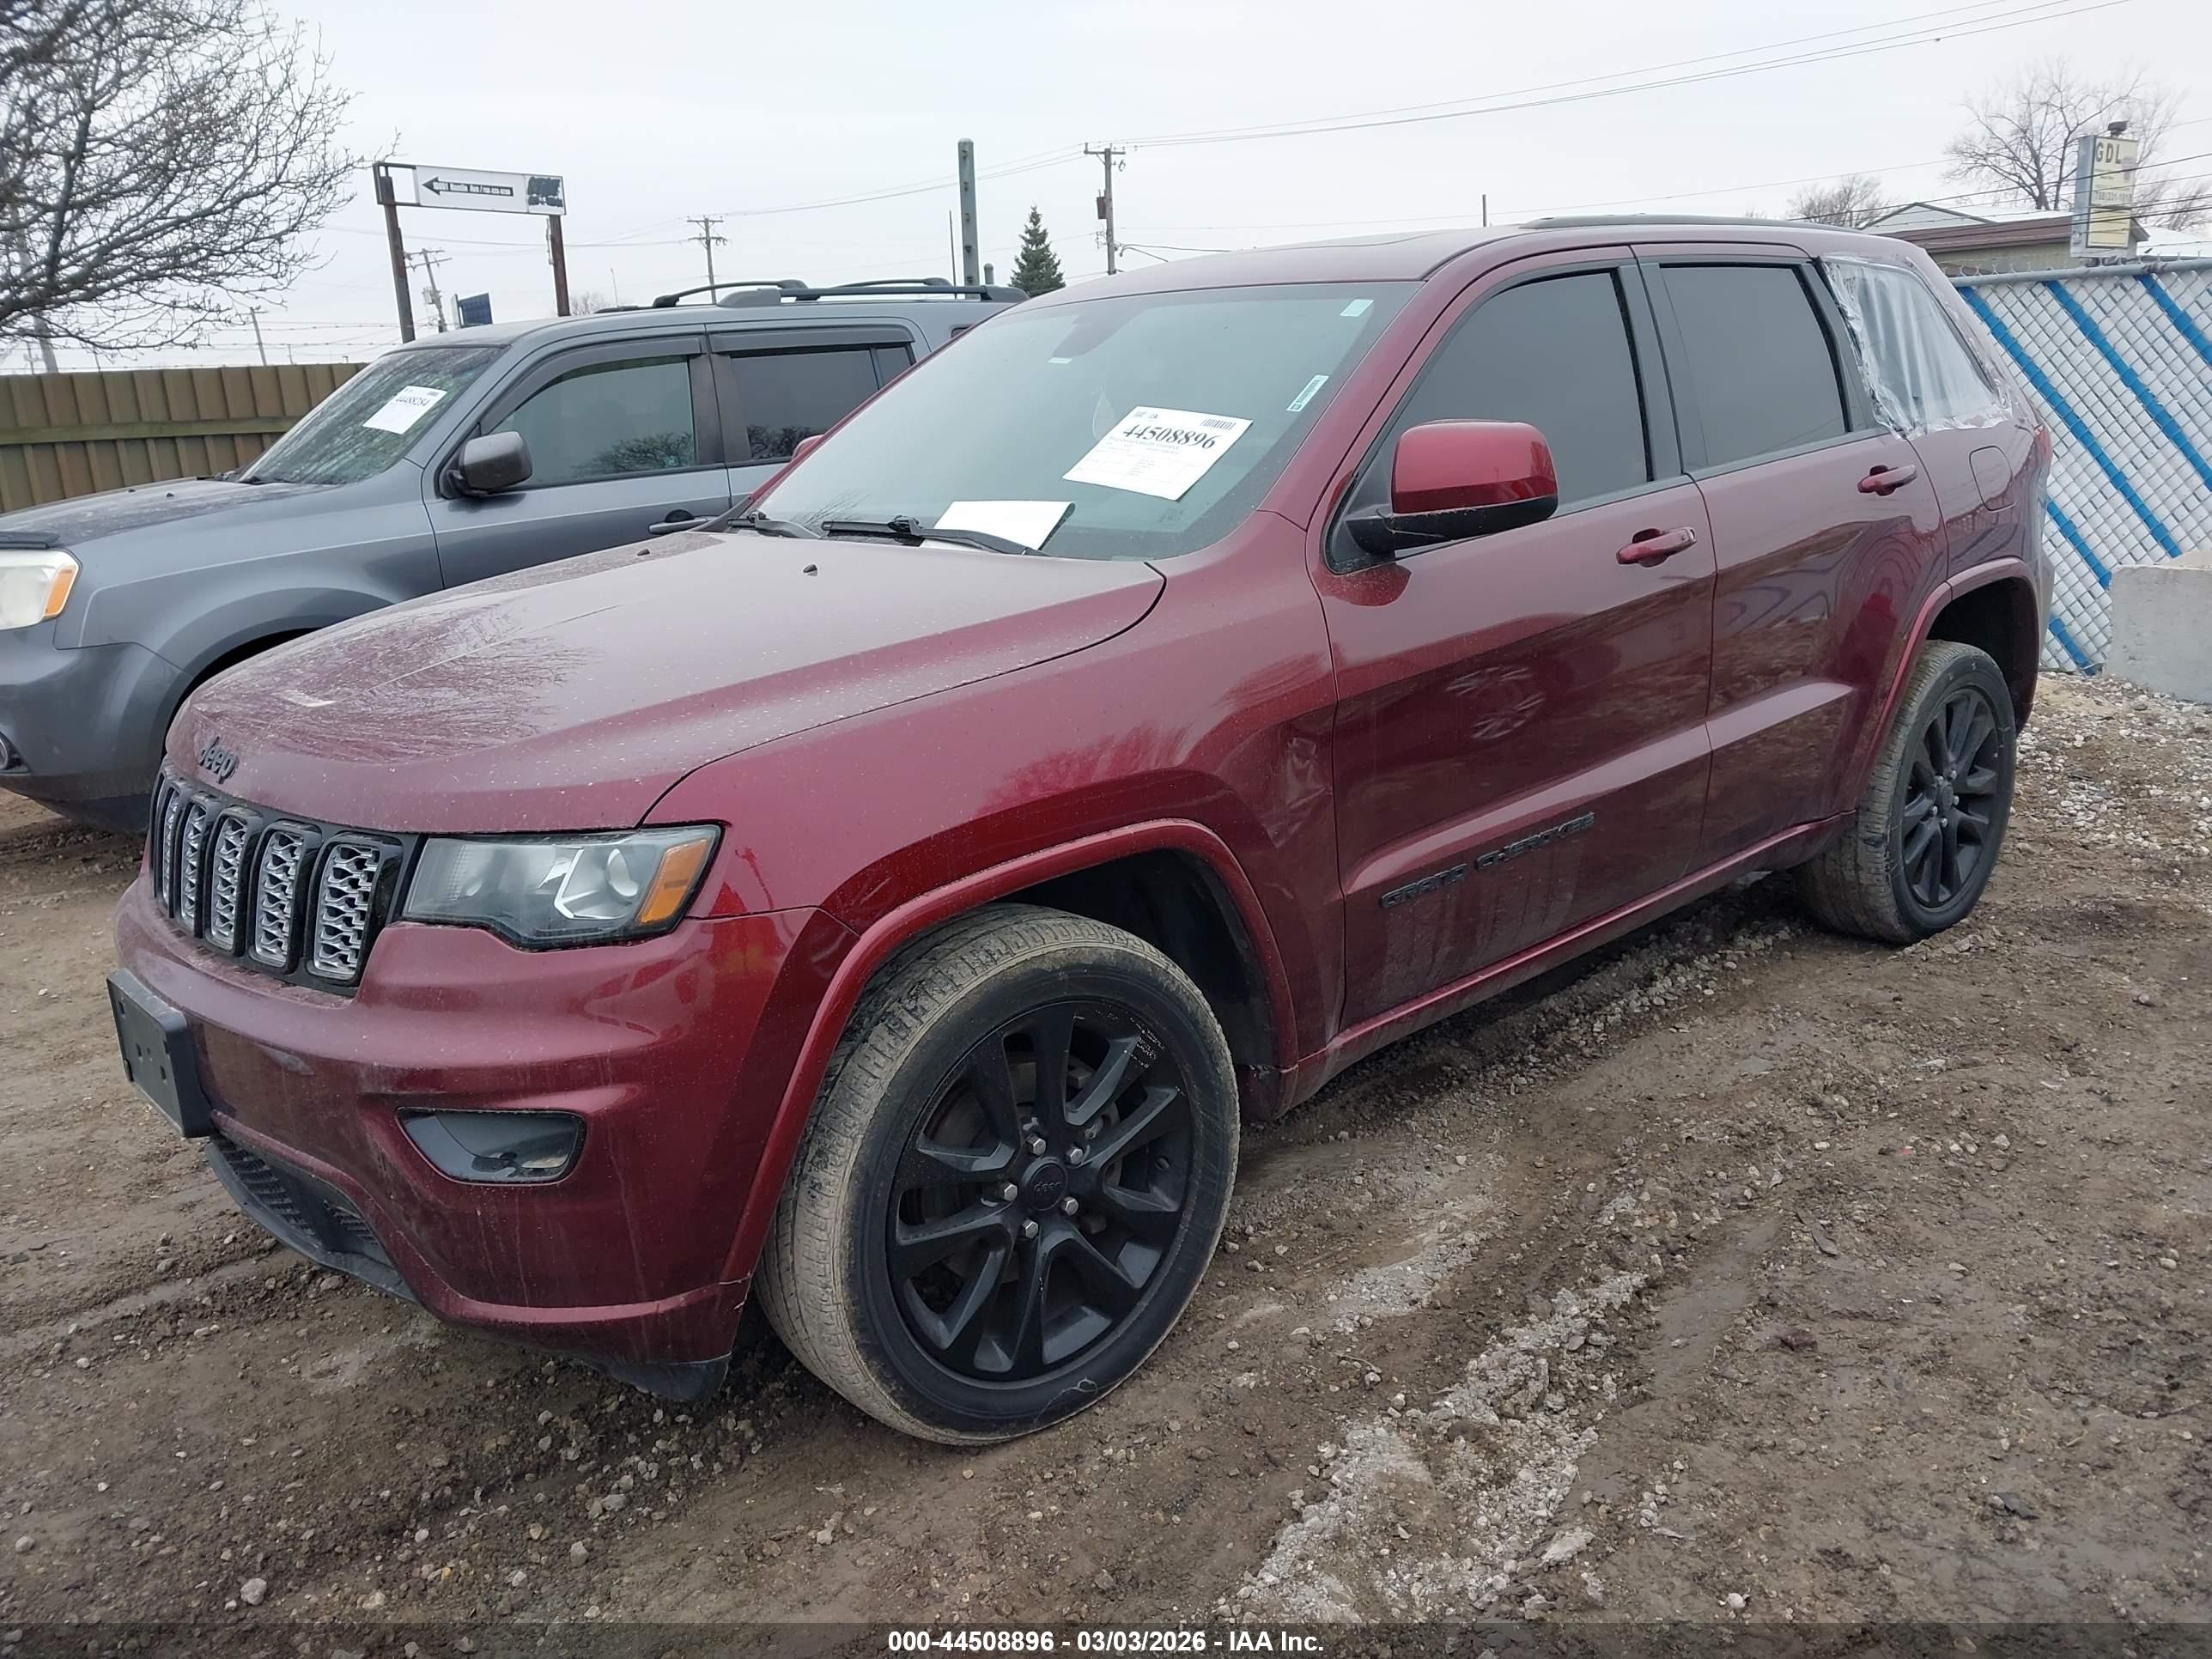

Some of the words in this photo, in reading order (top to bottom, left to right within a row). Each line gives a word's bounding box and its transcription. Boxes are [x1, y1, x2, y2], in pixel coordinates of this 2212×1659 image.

[2095, 142, 2122, 164] GDL
[1122, 424, 1222, 449] 44508896
[198, 736, 239, 785] Jeep
[1380, 862, 1468, 908] GRAND
[1475, 811, 1595, 871] CHEROKEE
